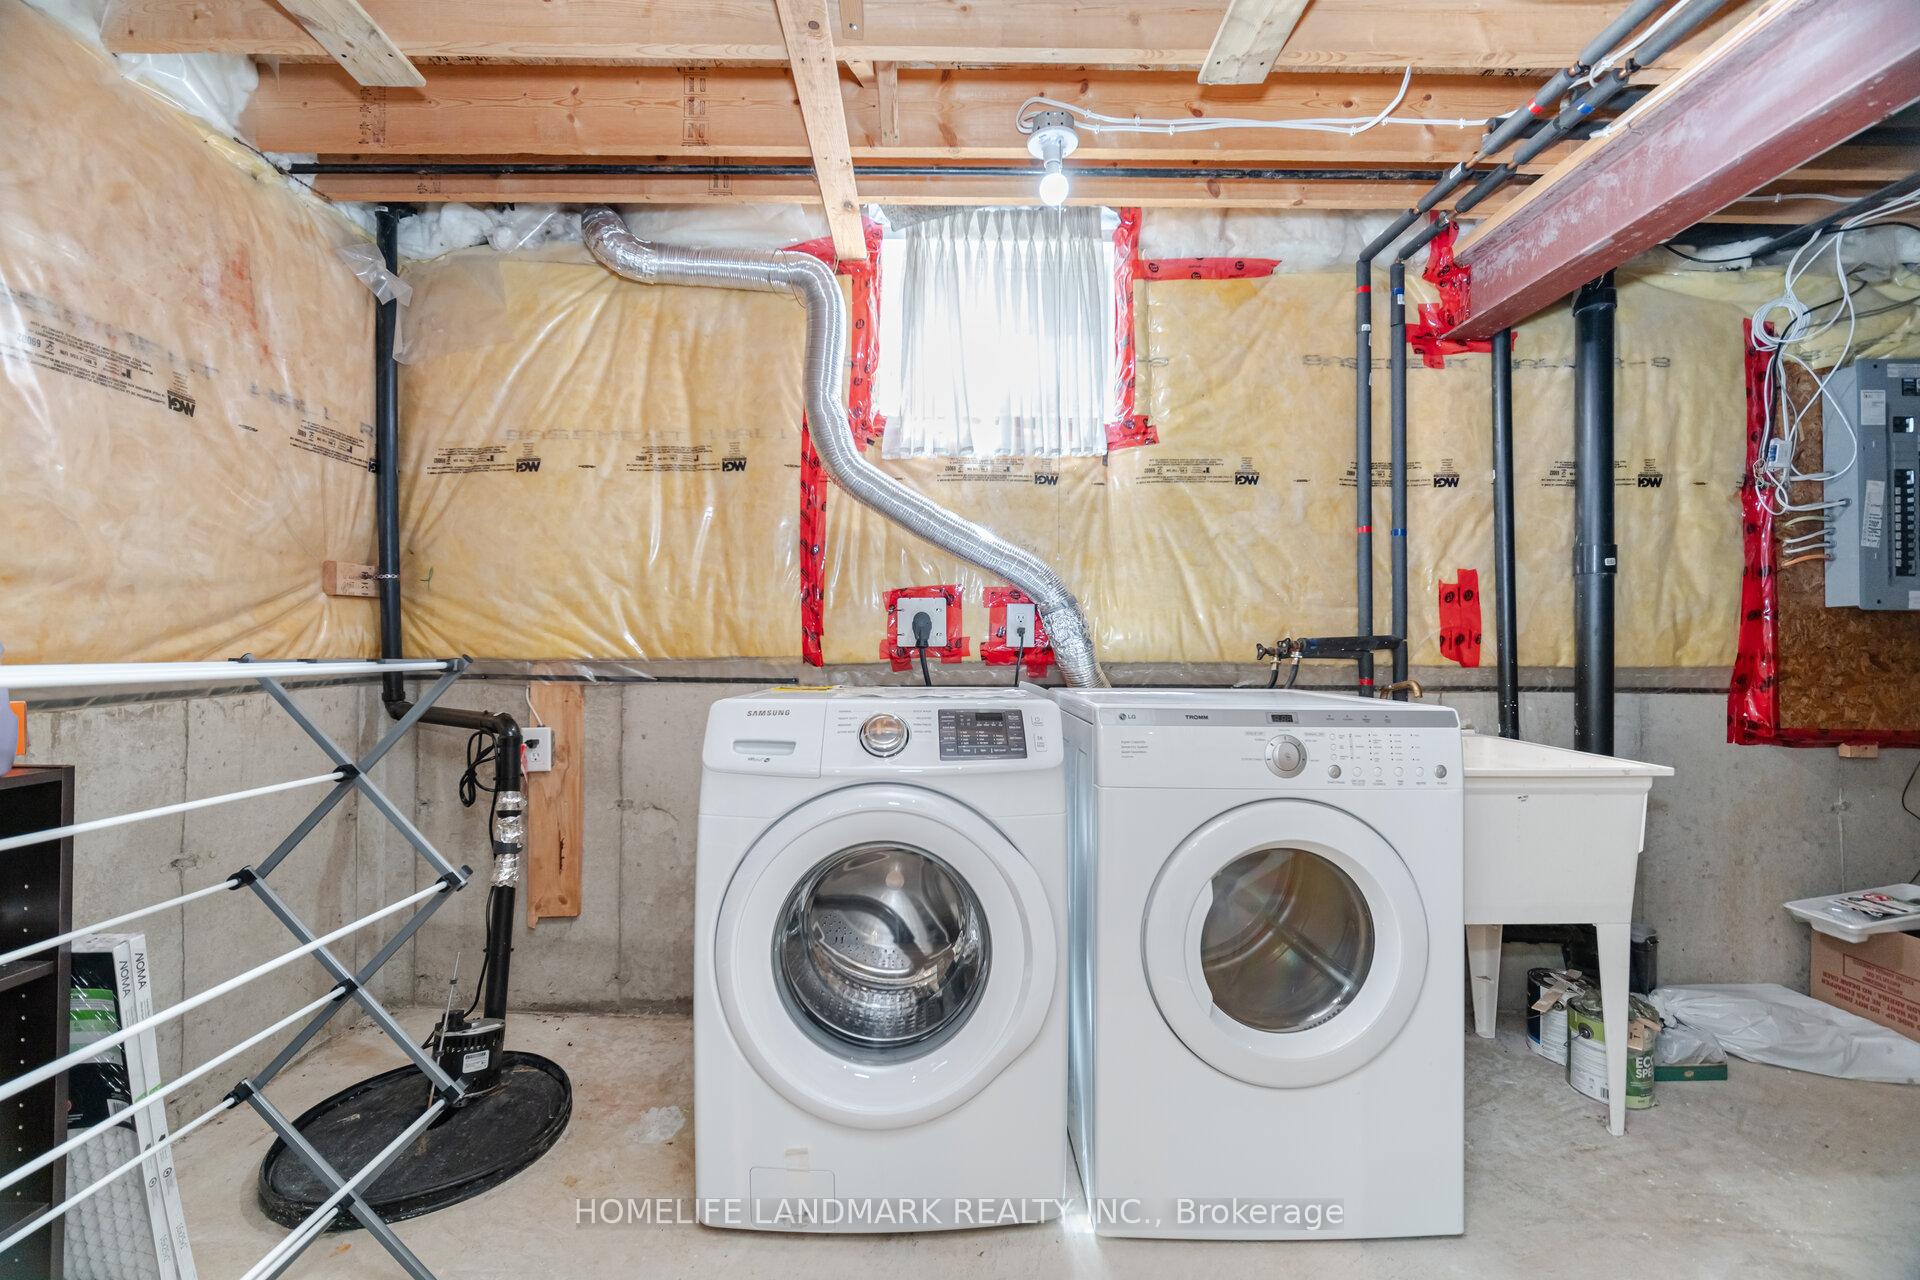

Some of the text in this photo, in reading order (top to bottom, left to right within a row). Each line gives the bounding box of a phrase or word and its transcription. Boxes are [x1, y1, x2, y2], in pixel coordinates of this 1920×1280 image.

[746, 709, 791, 717] SAMSUNG
[118, 960, 132, 999] NOMA
[134, 952, 148, 990] NOMA
